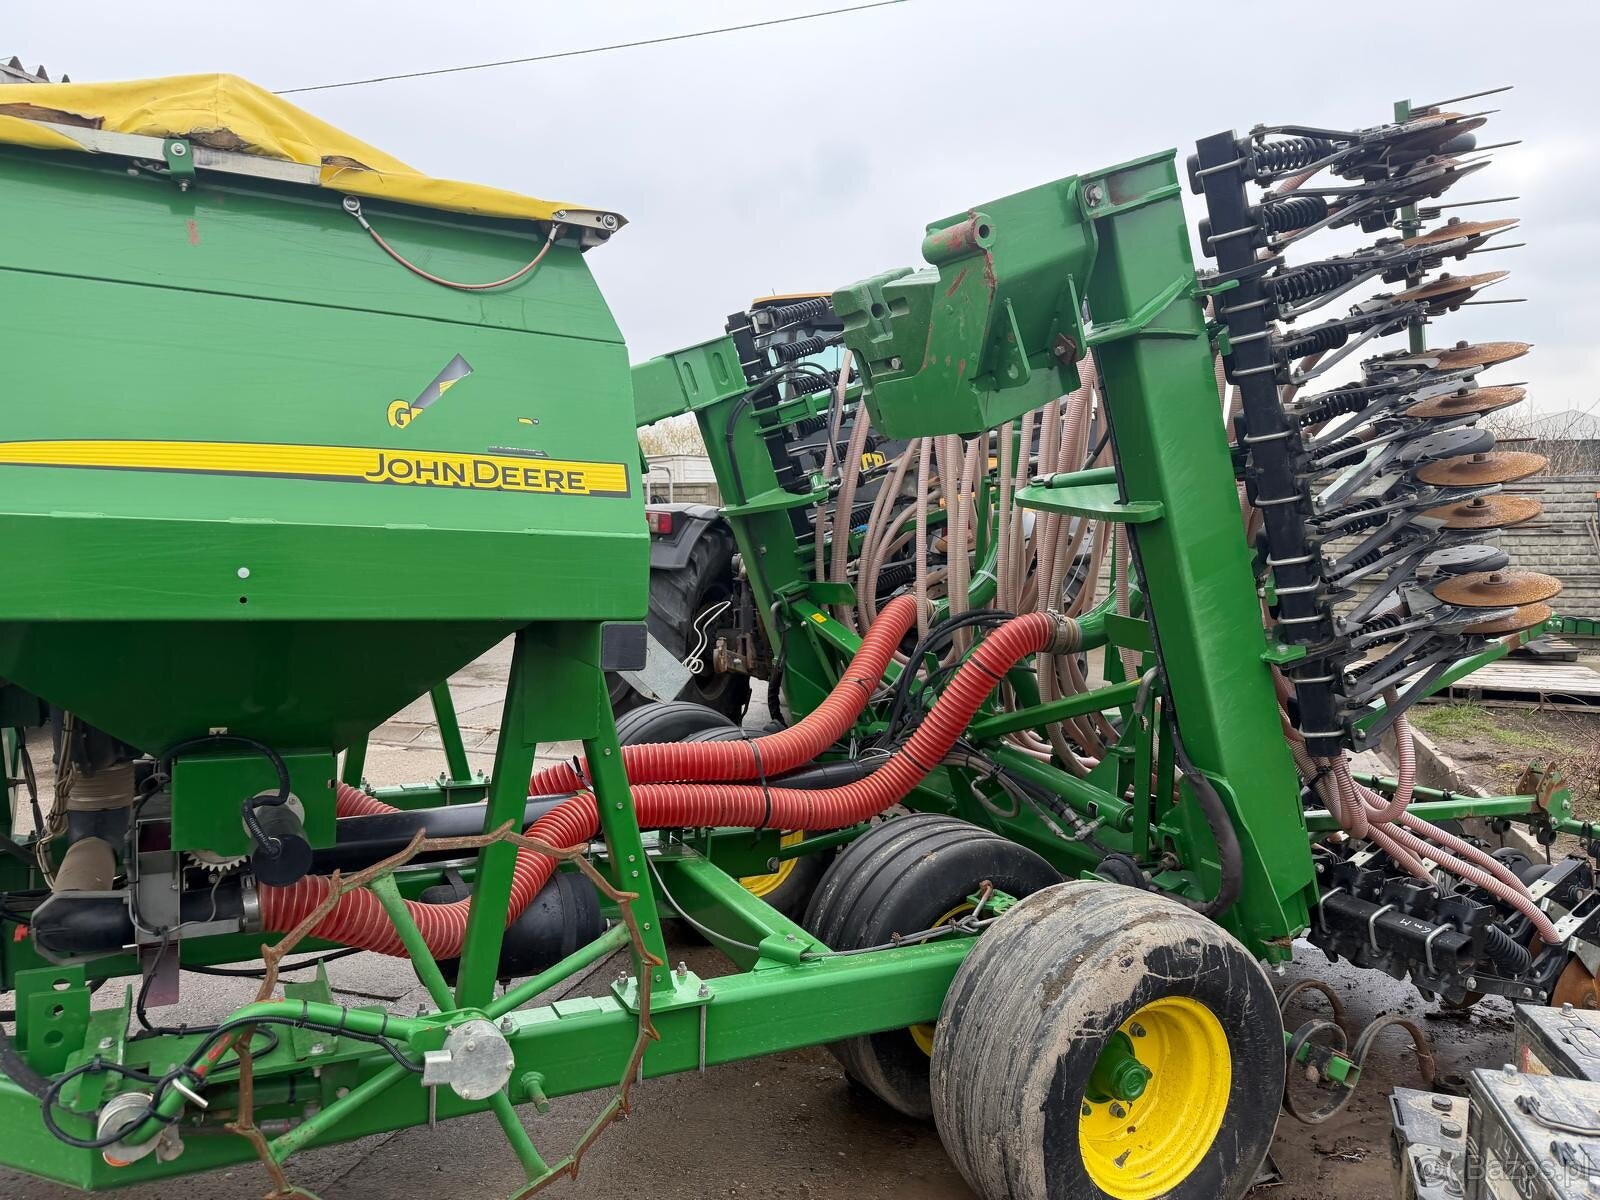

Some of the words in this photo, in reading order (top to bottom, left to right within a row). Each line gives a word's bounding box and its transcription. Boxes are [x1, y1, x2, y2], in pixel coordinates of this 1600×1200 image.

[366, 453, 465, 483] JOHN
[473, 460, 586, 490] DEERE
[860, 451, 885, 470] CB
